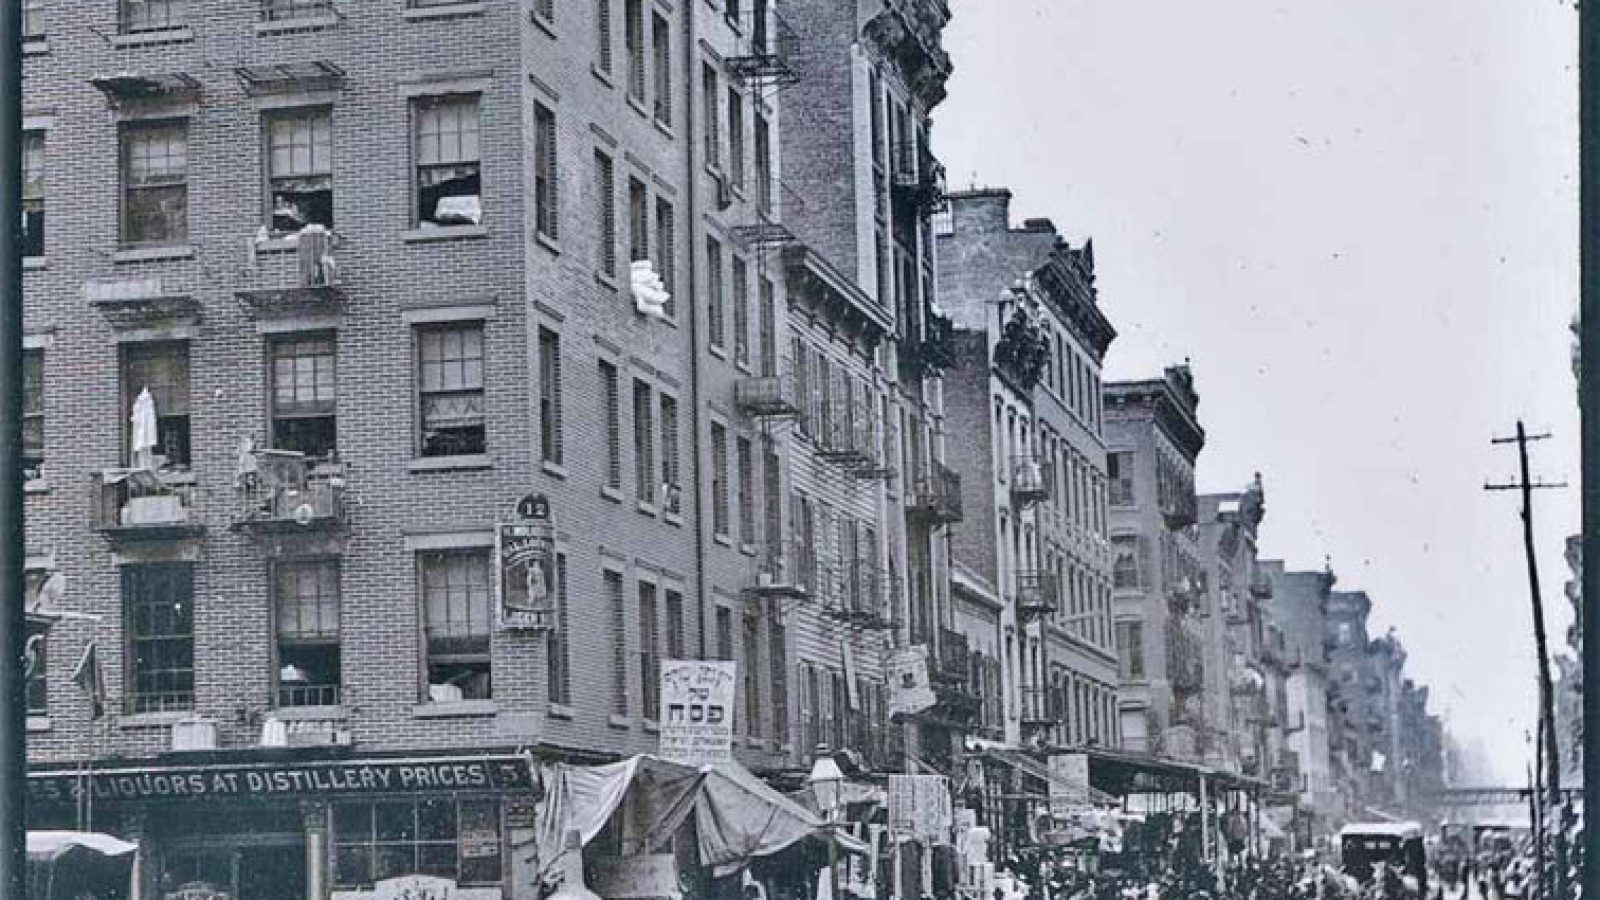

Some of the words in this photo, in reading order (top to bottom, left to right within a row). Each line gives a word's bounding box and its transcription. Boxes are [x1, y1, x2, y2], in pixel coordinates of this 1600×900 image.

[668, 704, 724, 723] פסח
[95, 774, 206, 797] LIQUORS
[213, 772, 239, 793] AT
[246, 766, 392, 791] DISTILLERY
[400, 763, 486, 786] PRICES
